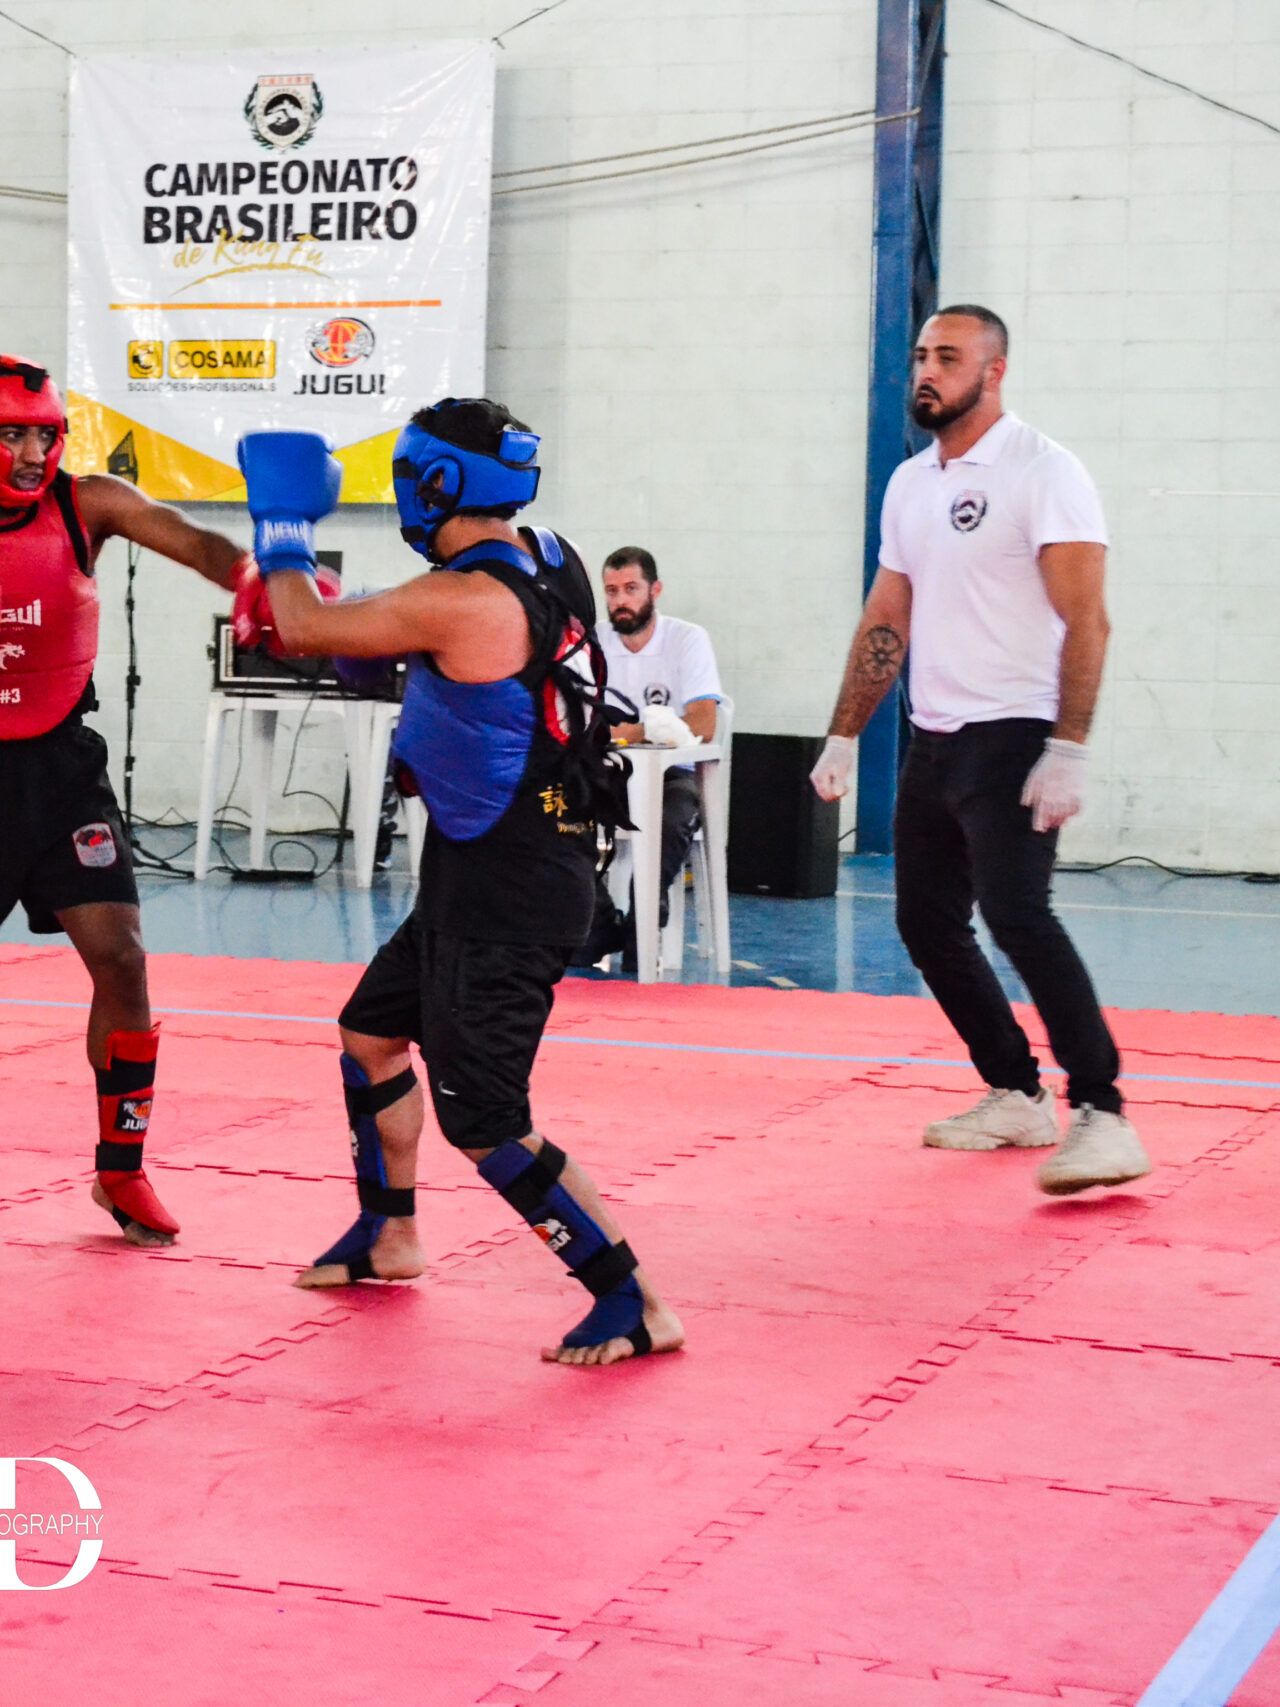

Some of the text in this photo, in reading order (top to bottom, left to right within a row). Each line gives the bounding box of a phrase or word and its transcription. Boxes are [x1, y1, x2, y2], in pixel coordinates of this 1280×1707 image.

[144, 156, 418, 198] CAMPEONATO
[143, 199, 418, 244] BRASILEIRO
[173, 227, 325, 268] de Kung Fu
[175, 350, 267, 369] COSAMA
[0, 599, 42, 627] GUI
